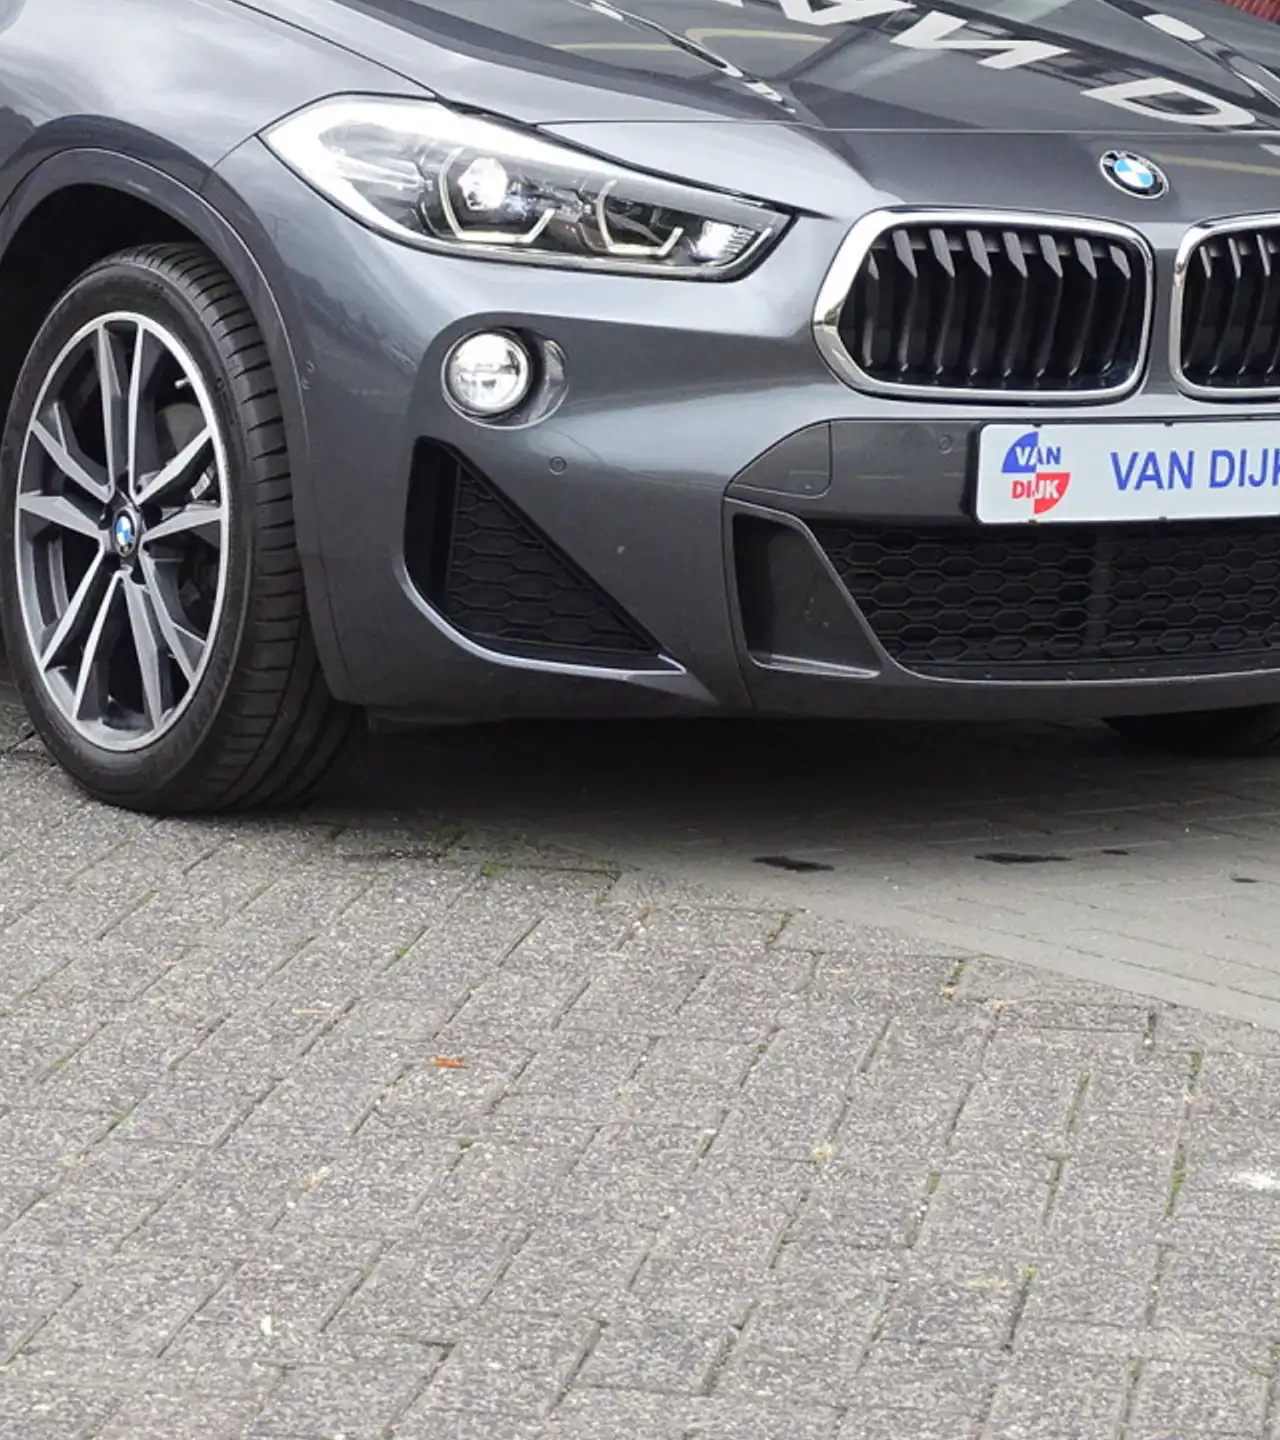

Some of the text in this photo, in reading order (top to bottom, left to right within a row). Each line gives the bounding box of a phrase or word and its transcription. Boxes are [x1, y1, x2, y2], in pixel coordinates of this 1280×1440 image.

[1015, 445, 1061, 466] VAN
[1110, 451, 1194, 491] VAN
[1011, 477, 1060, 500] DIJK
